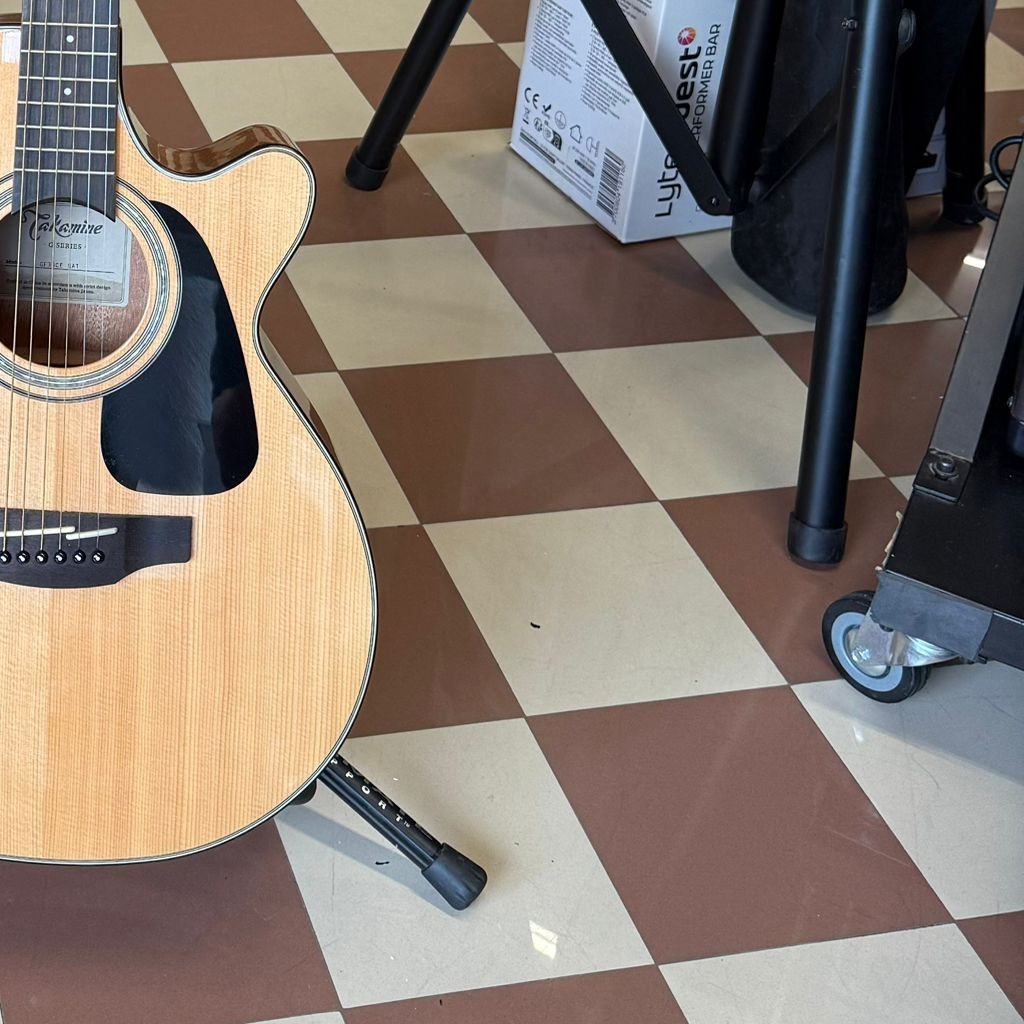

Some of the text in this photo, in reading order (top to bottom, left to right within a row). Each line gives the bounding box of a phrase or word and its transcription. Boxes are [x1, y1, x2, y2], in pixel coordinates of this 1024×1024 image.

[705, 23, 722, 56] BAR
[655, 45, 702, 217] Lyteuest
[21, 209, 104, 241] Takamine
[56, 242, 82, 250] SERIES
